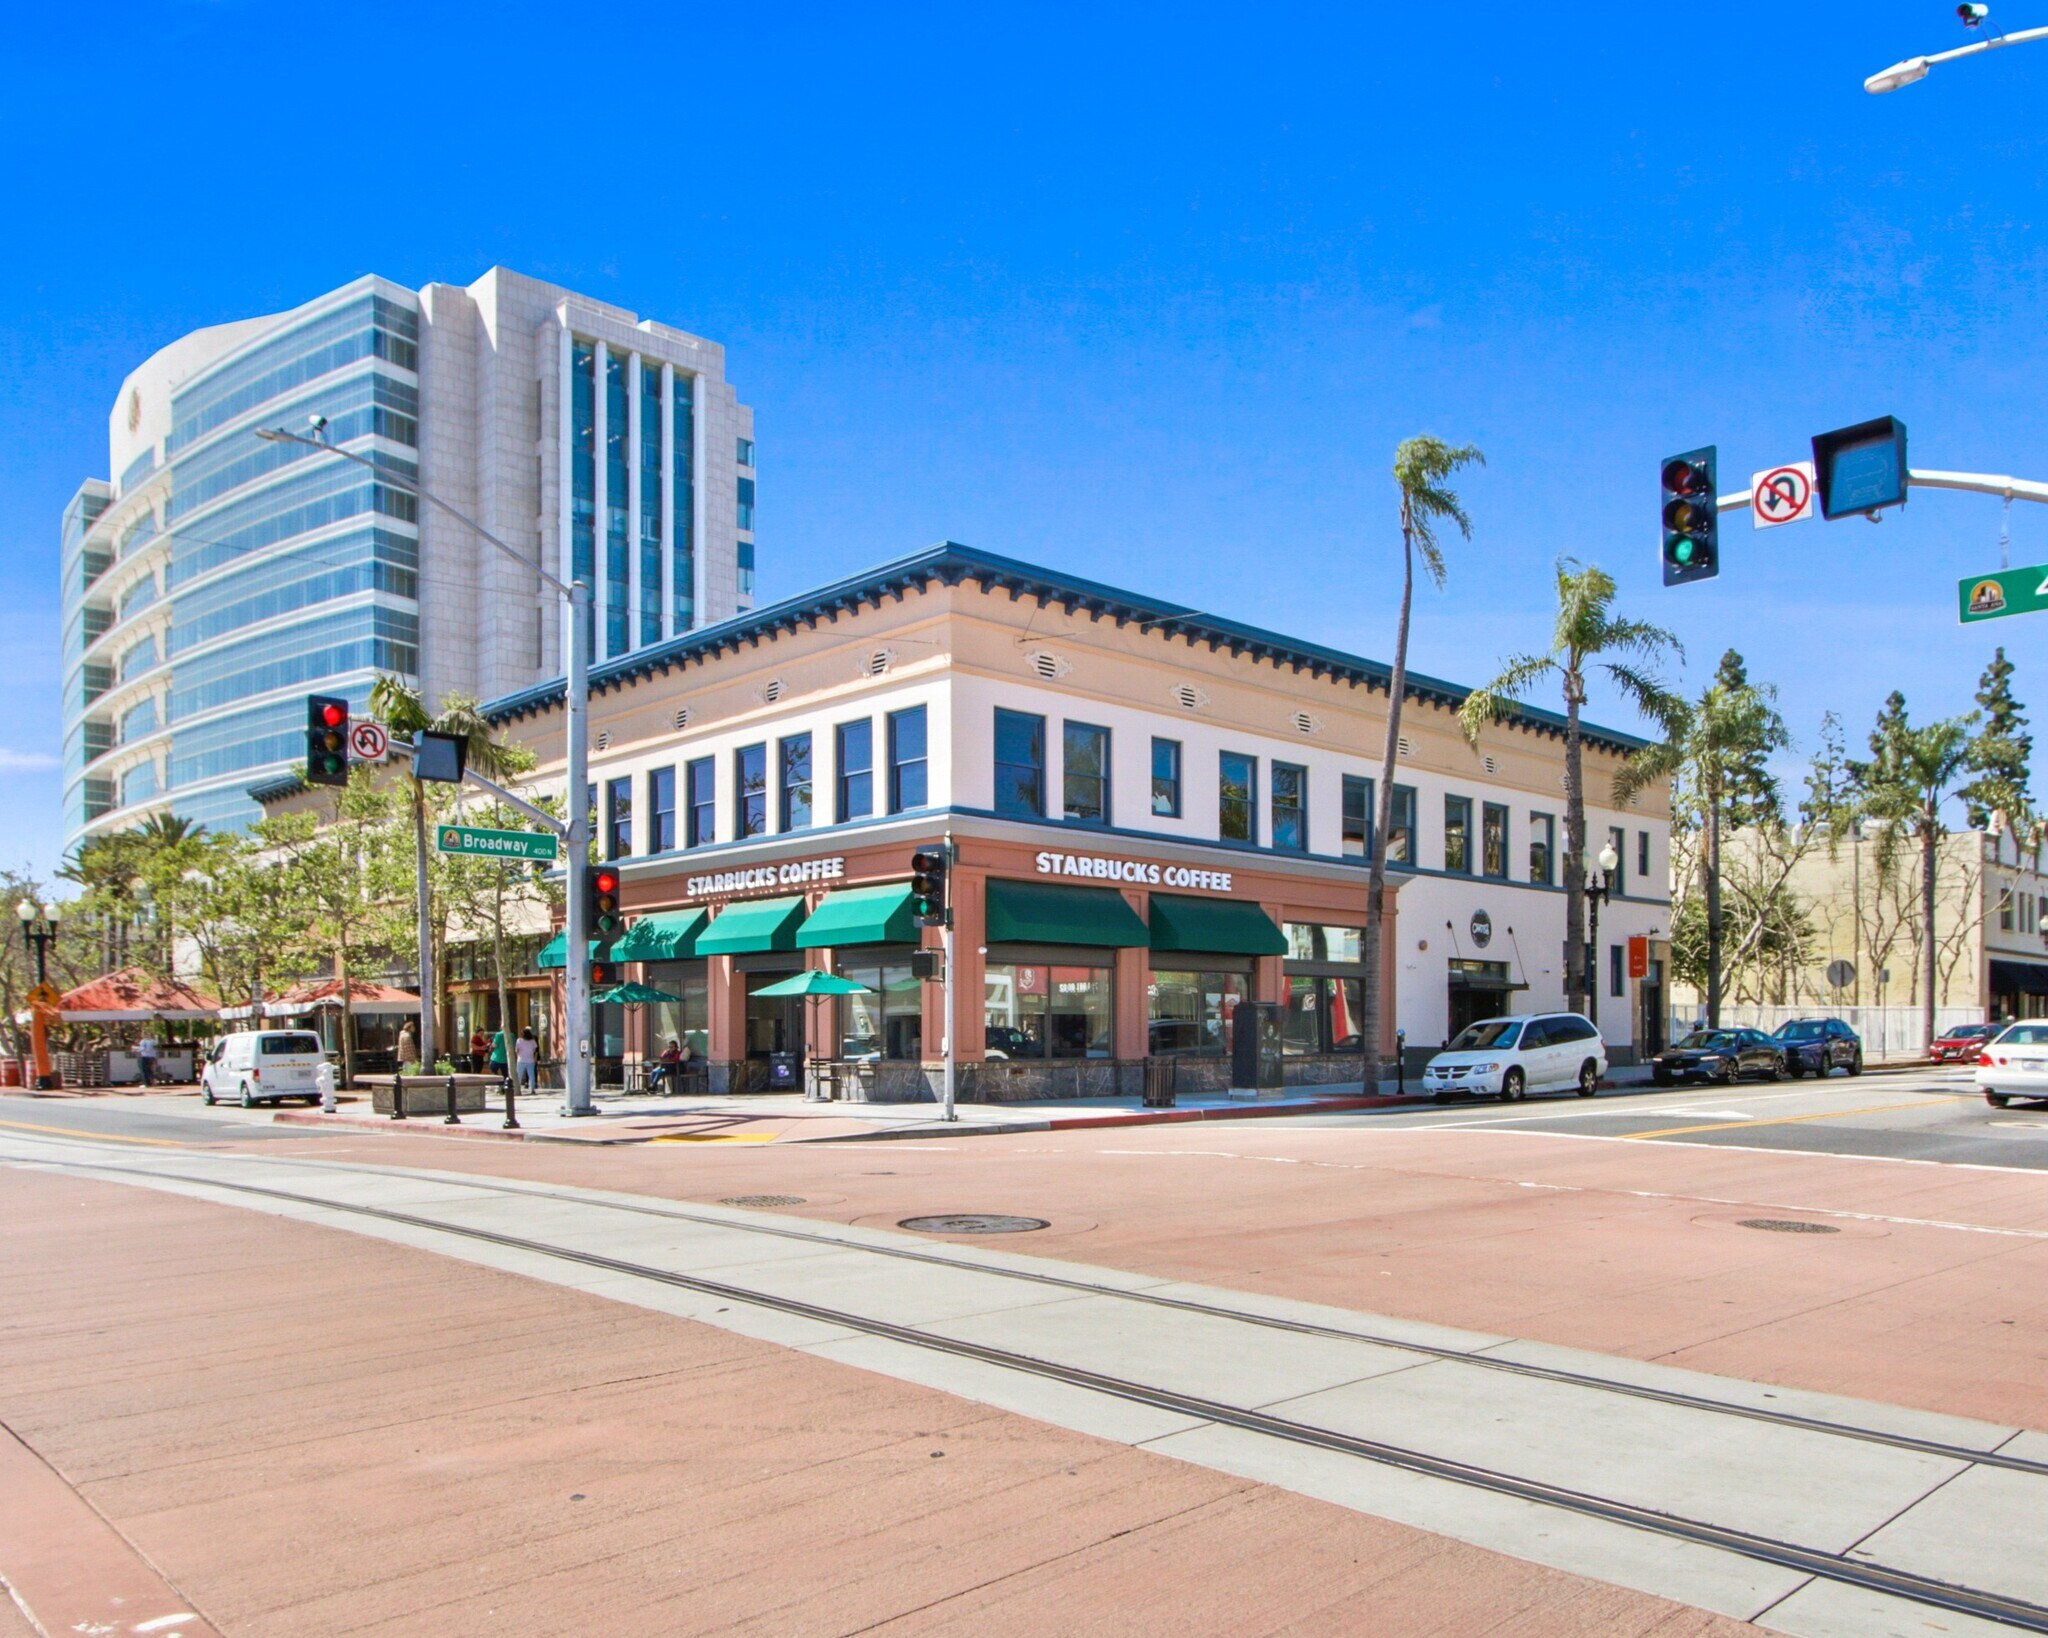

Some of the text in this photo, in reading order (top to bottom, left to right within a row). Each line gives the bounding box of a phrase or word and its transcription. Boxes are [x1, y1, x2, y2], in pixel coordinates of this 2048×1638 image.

[464, 834, 528, 855] Broadway
[533, 847, 546, 855] 400
[687, 857, 844, 896] STARBUCKS COFFEE
[1035, 851, 1232, 892] STARBUCKS COFFEE
